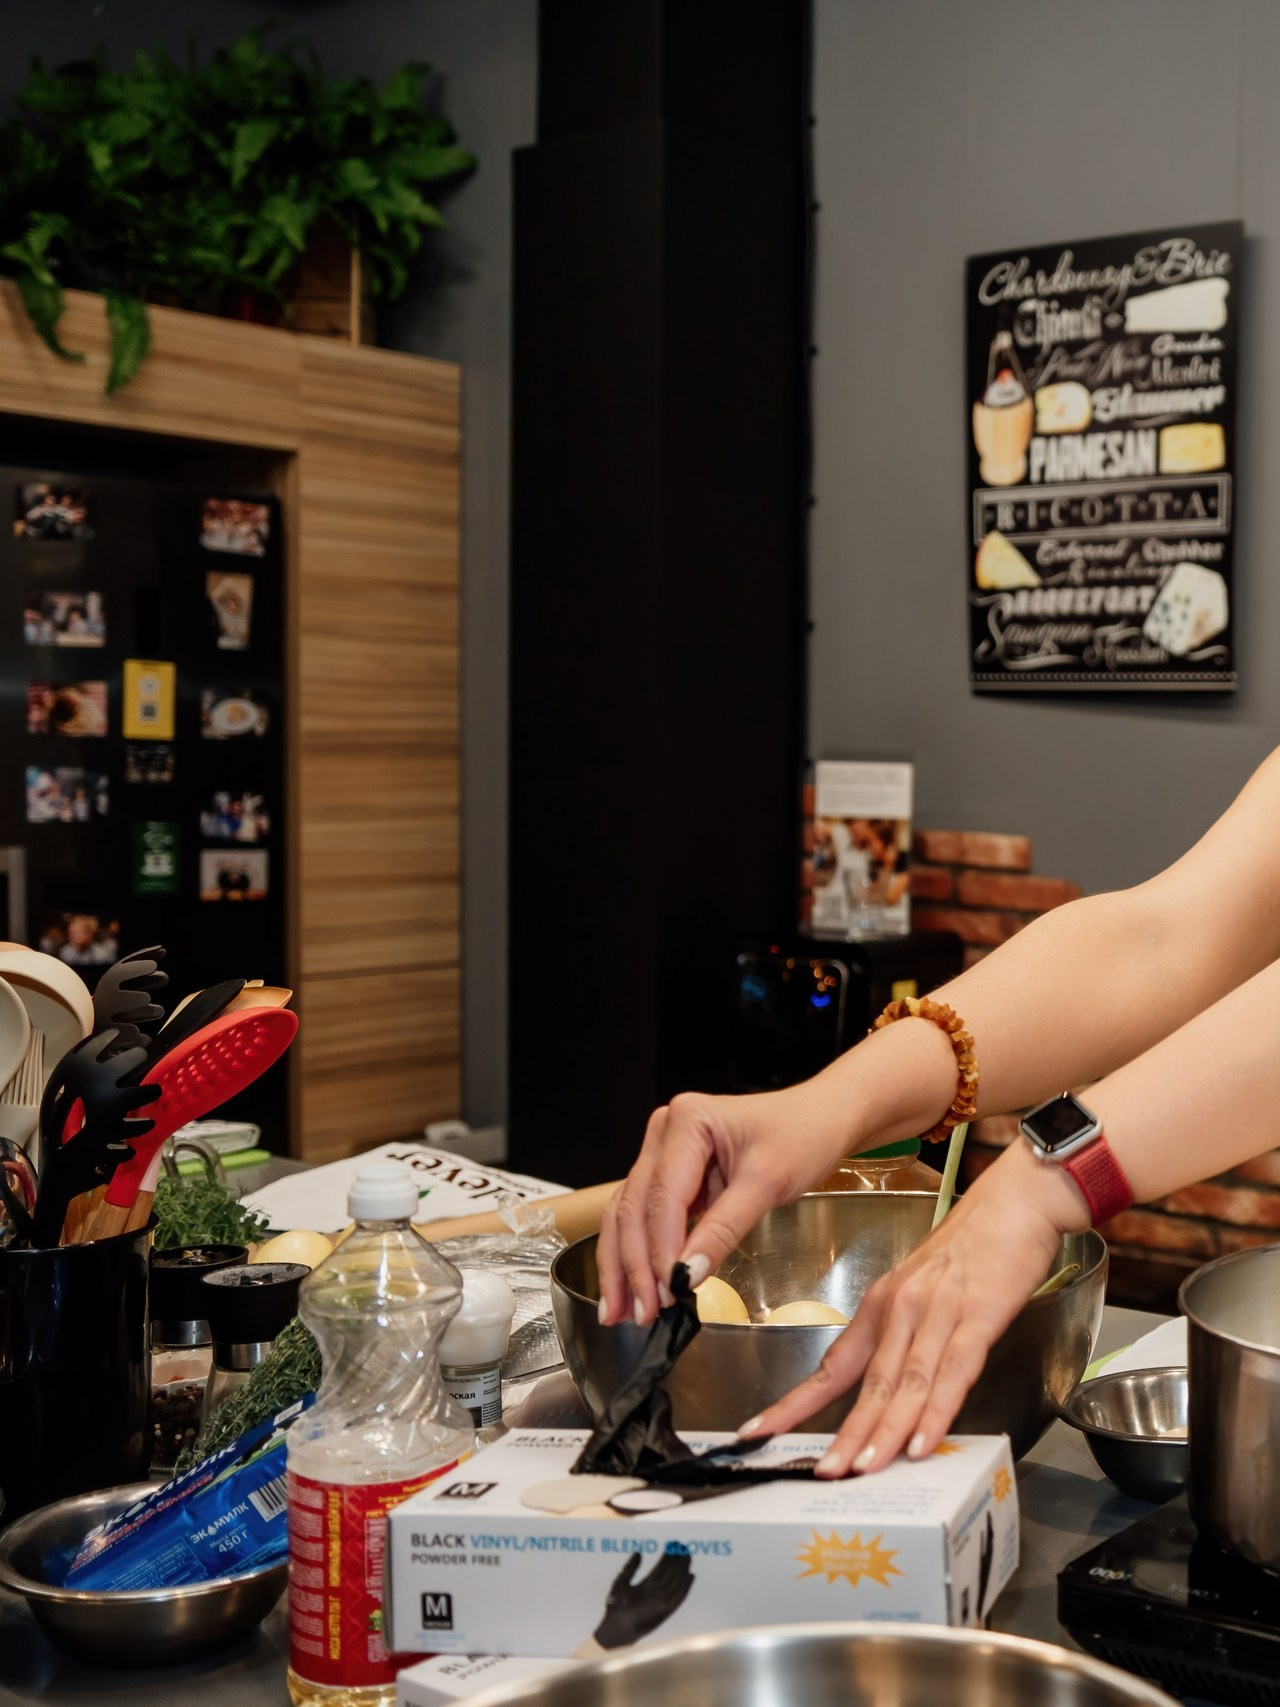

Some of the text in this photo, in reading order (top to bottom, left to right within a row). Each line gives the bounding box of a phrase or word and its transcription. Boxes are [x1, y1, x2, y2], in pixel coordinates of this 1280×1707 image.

[978, 249, 1134, 312] Chardonnay
[1155, 237, 1234, 285] Brie
[1030, 427, 1157, 485] PARMESAN
[218, 1534, 241, 1553] 450
[410, 1533, 733, 1556] BLACK VINYL/NITRILE BLEND GLOVES
[411, 1553, 501, 1567] POWDER FREE
[425, 1594, 449, 1617] M
